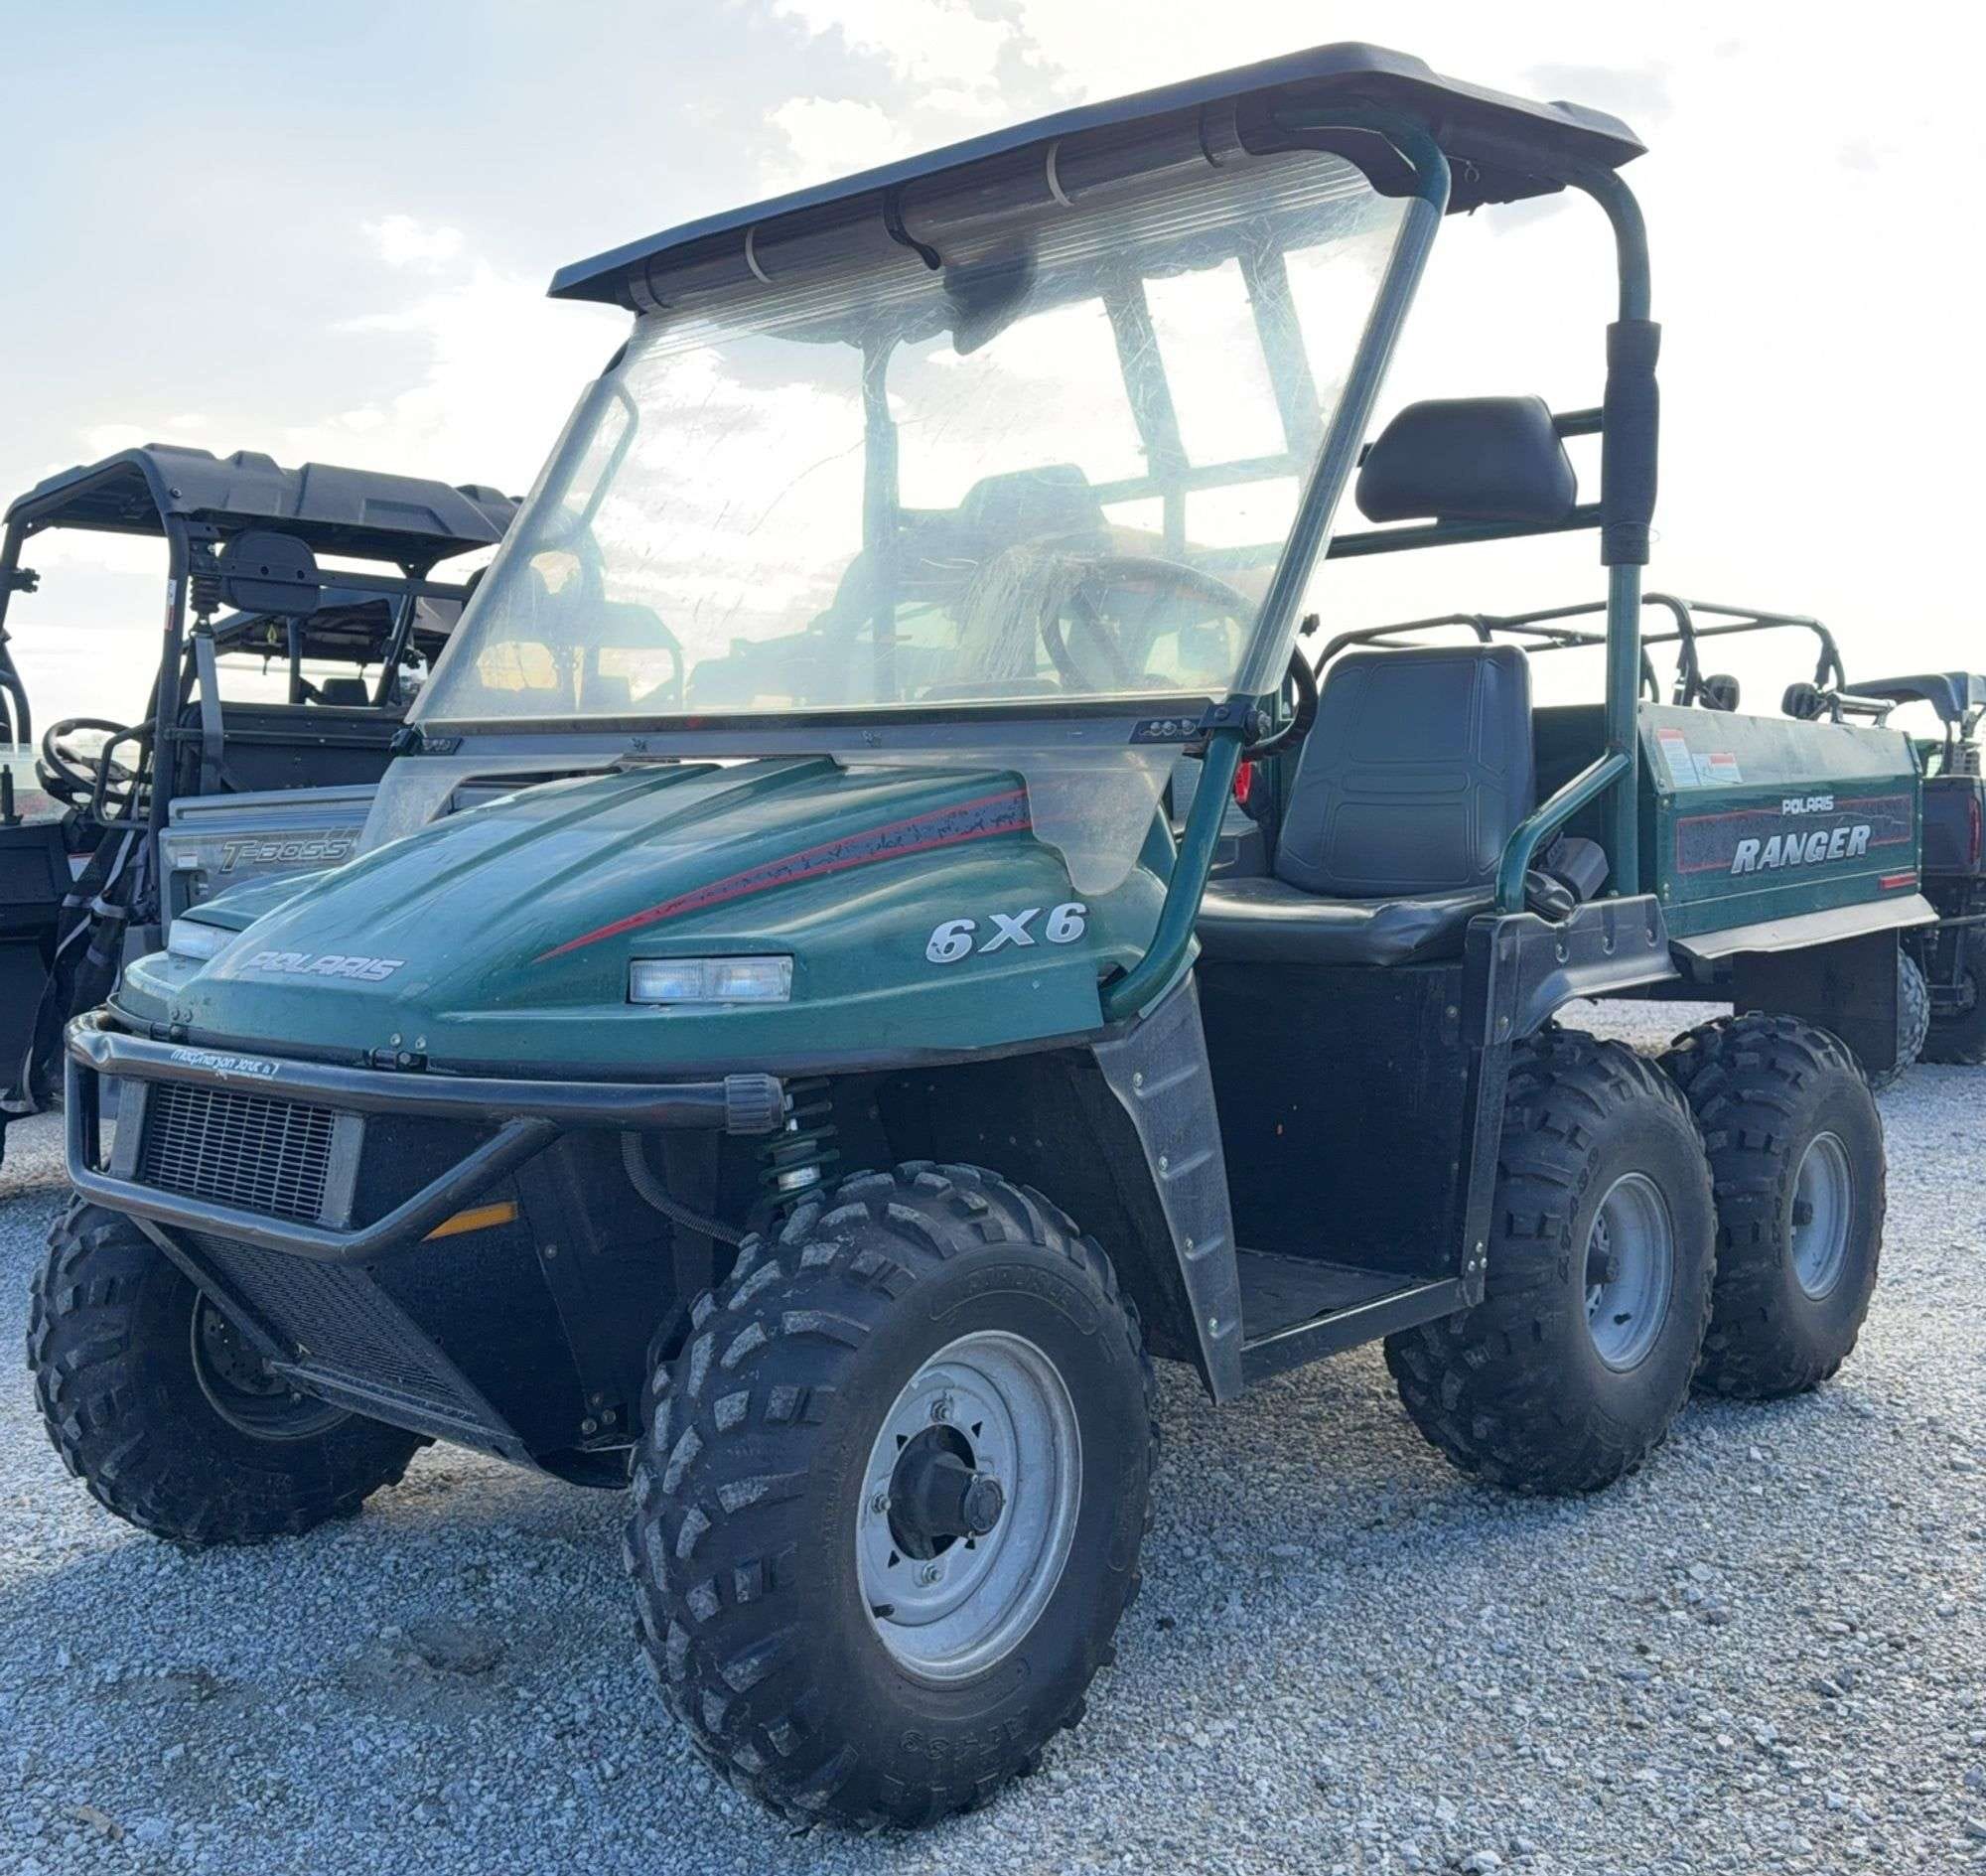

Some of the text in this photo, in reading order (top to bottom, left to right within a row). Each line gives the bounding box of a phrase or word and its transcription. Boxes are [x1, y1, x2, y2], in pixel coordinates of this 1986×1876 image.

[1782, 795, 1834, 815] POLARIS
[221, 839, 351, 872] T-BOSS
[1731, 824, 1873, 876] RANGER
[240, 950, 405, 981] POLARIS
